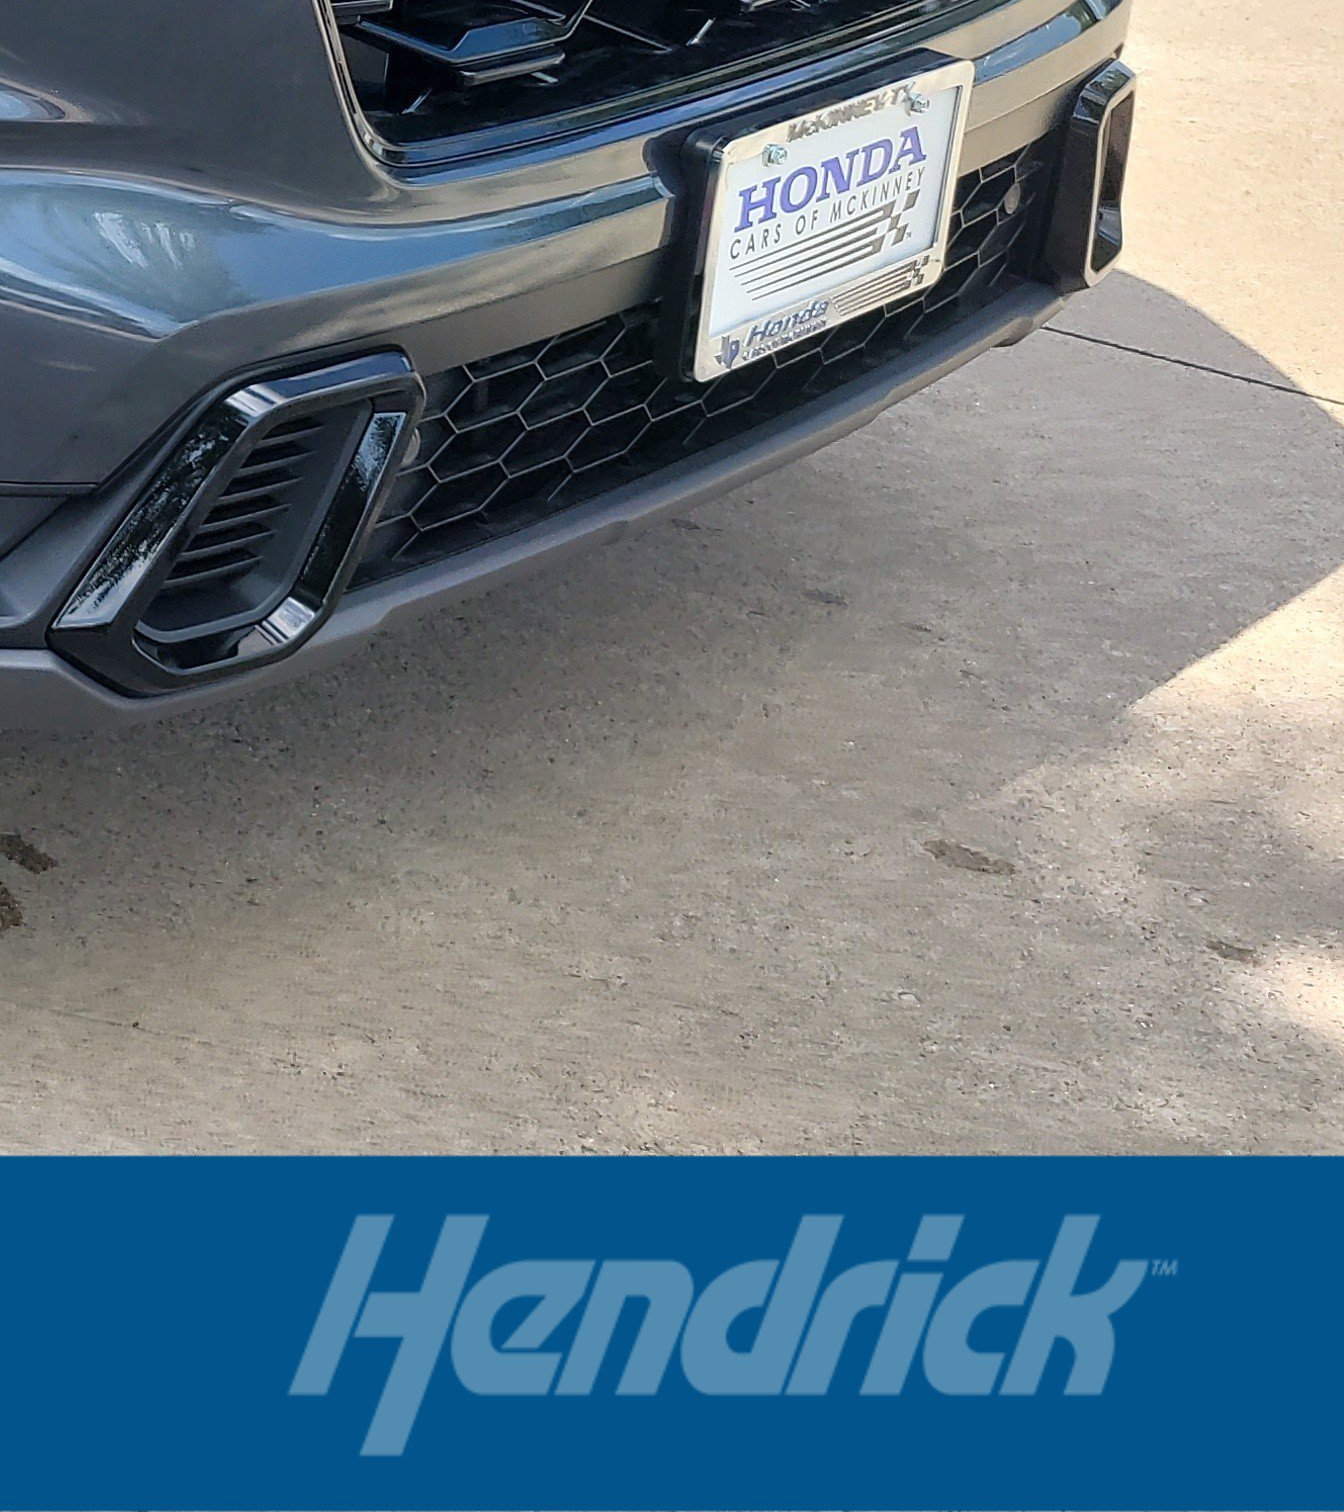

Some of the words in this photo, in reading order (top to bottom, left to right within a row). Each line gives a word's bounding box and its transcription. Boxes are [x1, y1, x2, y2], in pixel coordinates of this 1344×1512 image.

[730, 223, 782, 260] CARS
[795, 209, 819, 235] OF
[829, 166, 926, 223] MCKINNEY
[734, 126, 926, 233] HONDA
[743, 300, 829, 348] Honda
